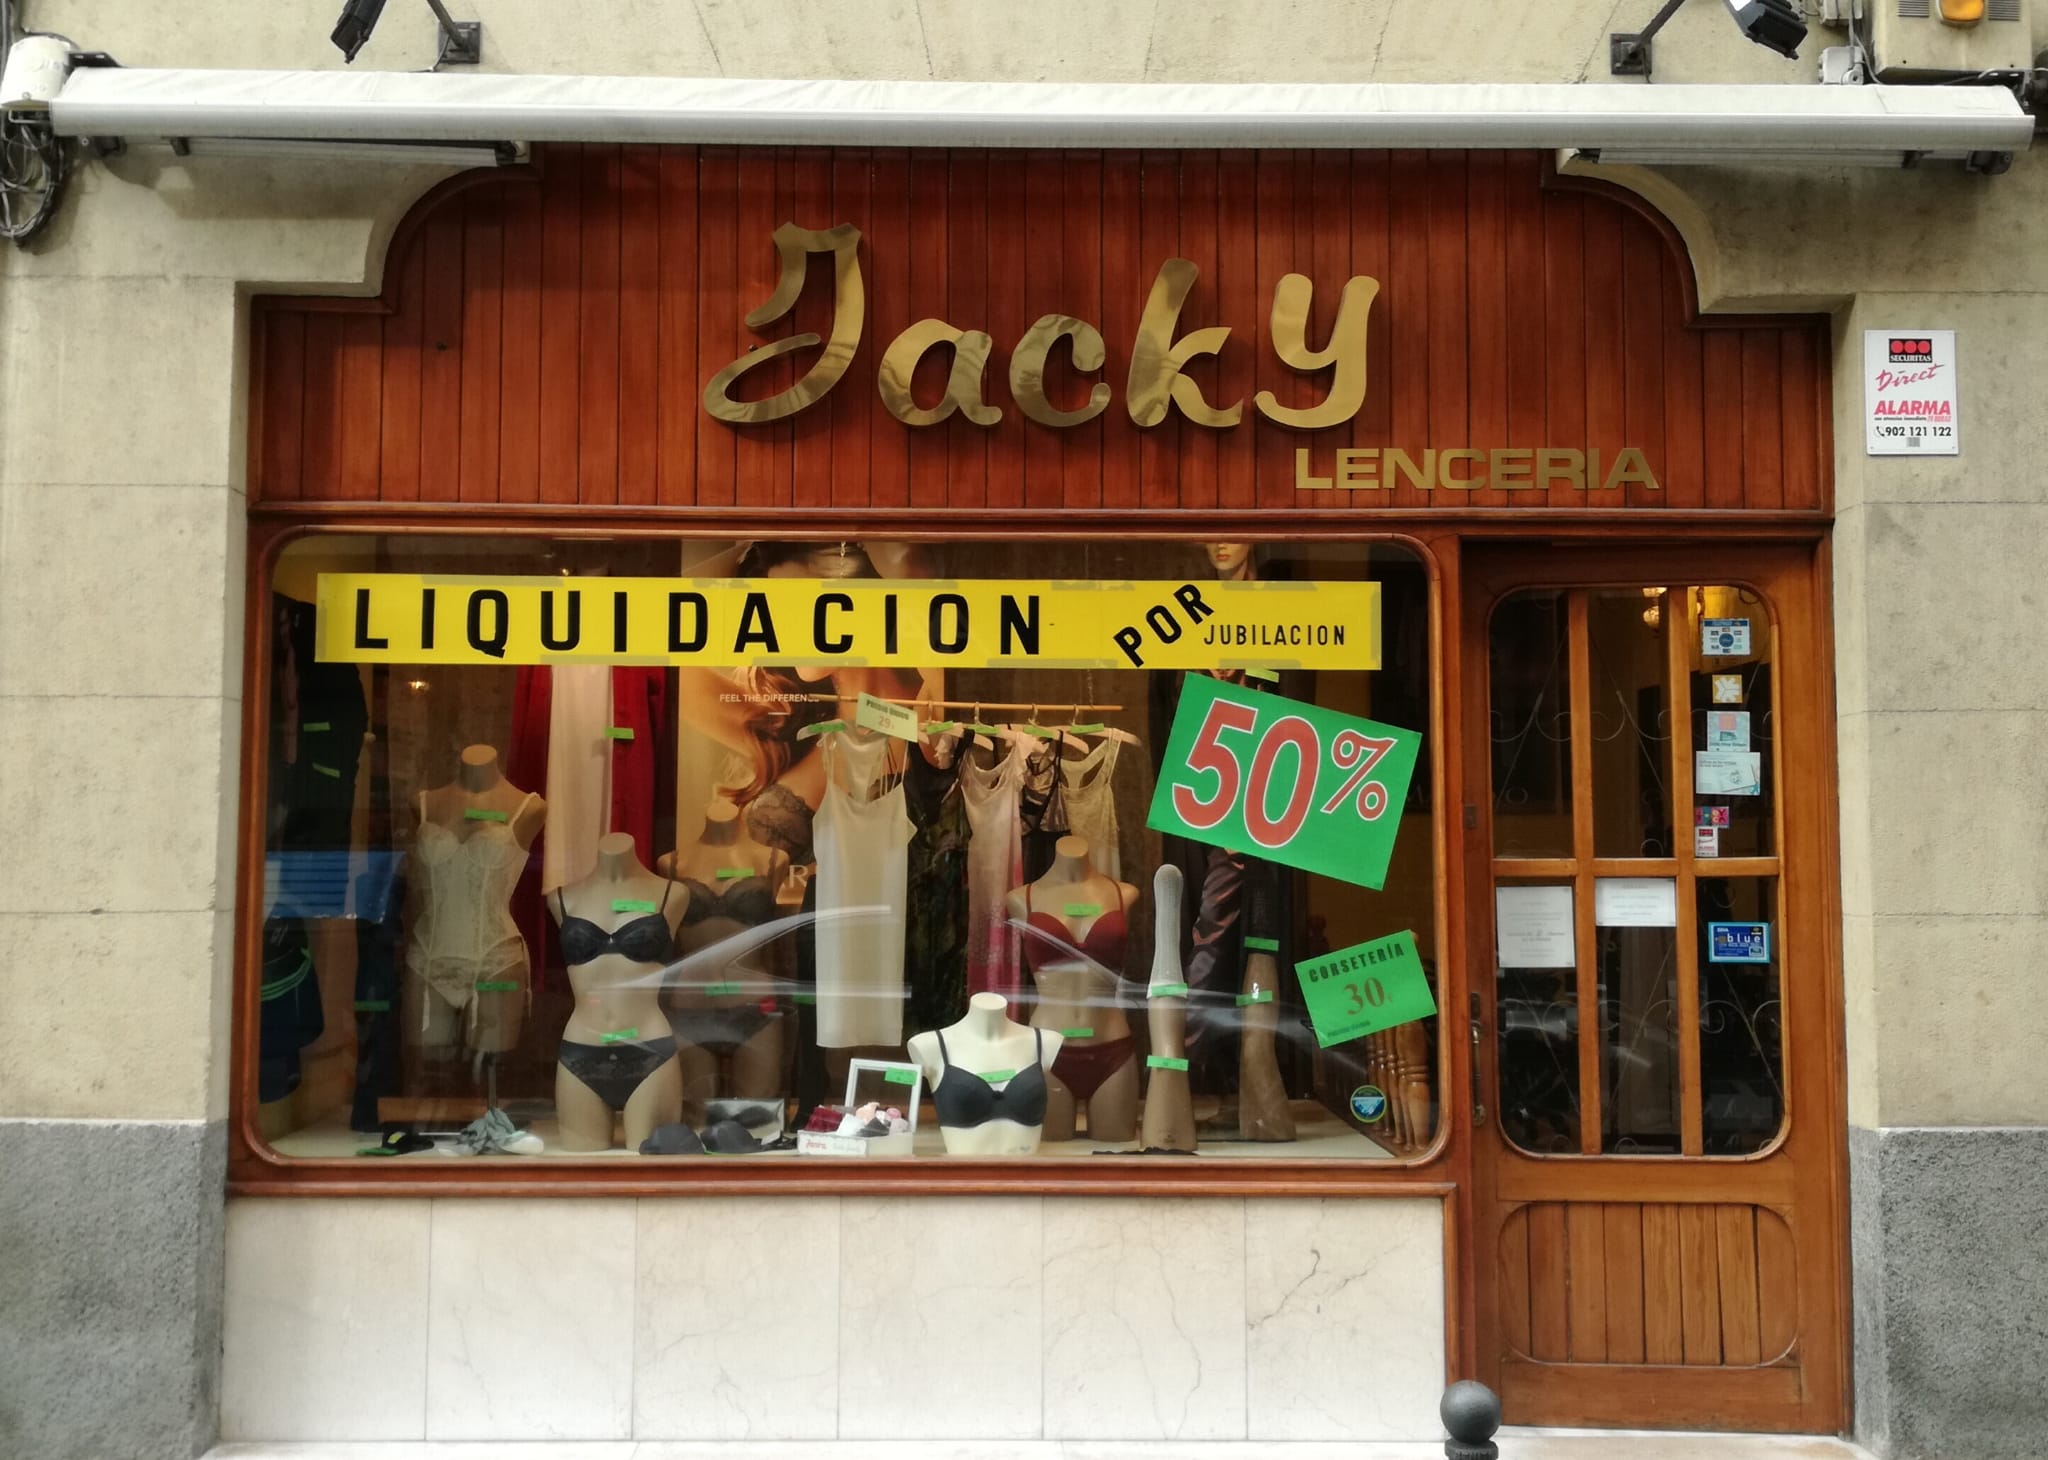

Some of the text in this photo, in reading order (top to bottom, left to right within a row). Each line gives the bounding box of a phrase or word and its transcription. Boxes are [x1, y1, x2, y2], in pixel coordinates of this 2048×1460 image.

[703, 222, 1380, 428] Jacky
[1875, 363, 1945, 392] Direct
[1874, 400, 1951, 415] ALARMA
[1885, 426, 1952, 437] 902 121 122
[1295, 447, 1660, 490] LENCERIA
[355, 588, 1040, 659] LIQUIDACION
[1112, 584, 1215, 668] POR
[1203, 624, 1345, 646] JUBILACION
[719, 694, 741, 703] FEEL
[743, 694, 761, 703] THE
[1172, 697, 1399, 849] 50%
[1727, 933, 1761, 943] blue
[1309, 943, 1404, 983] CORSETERÍA
